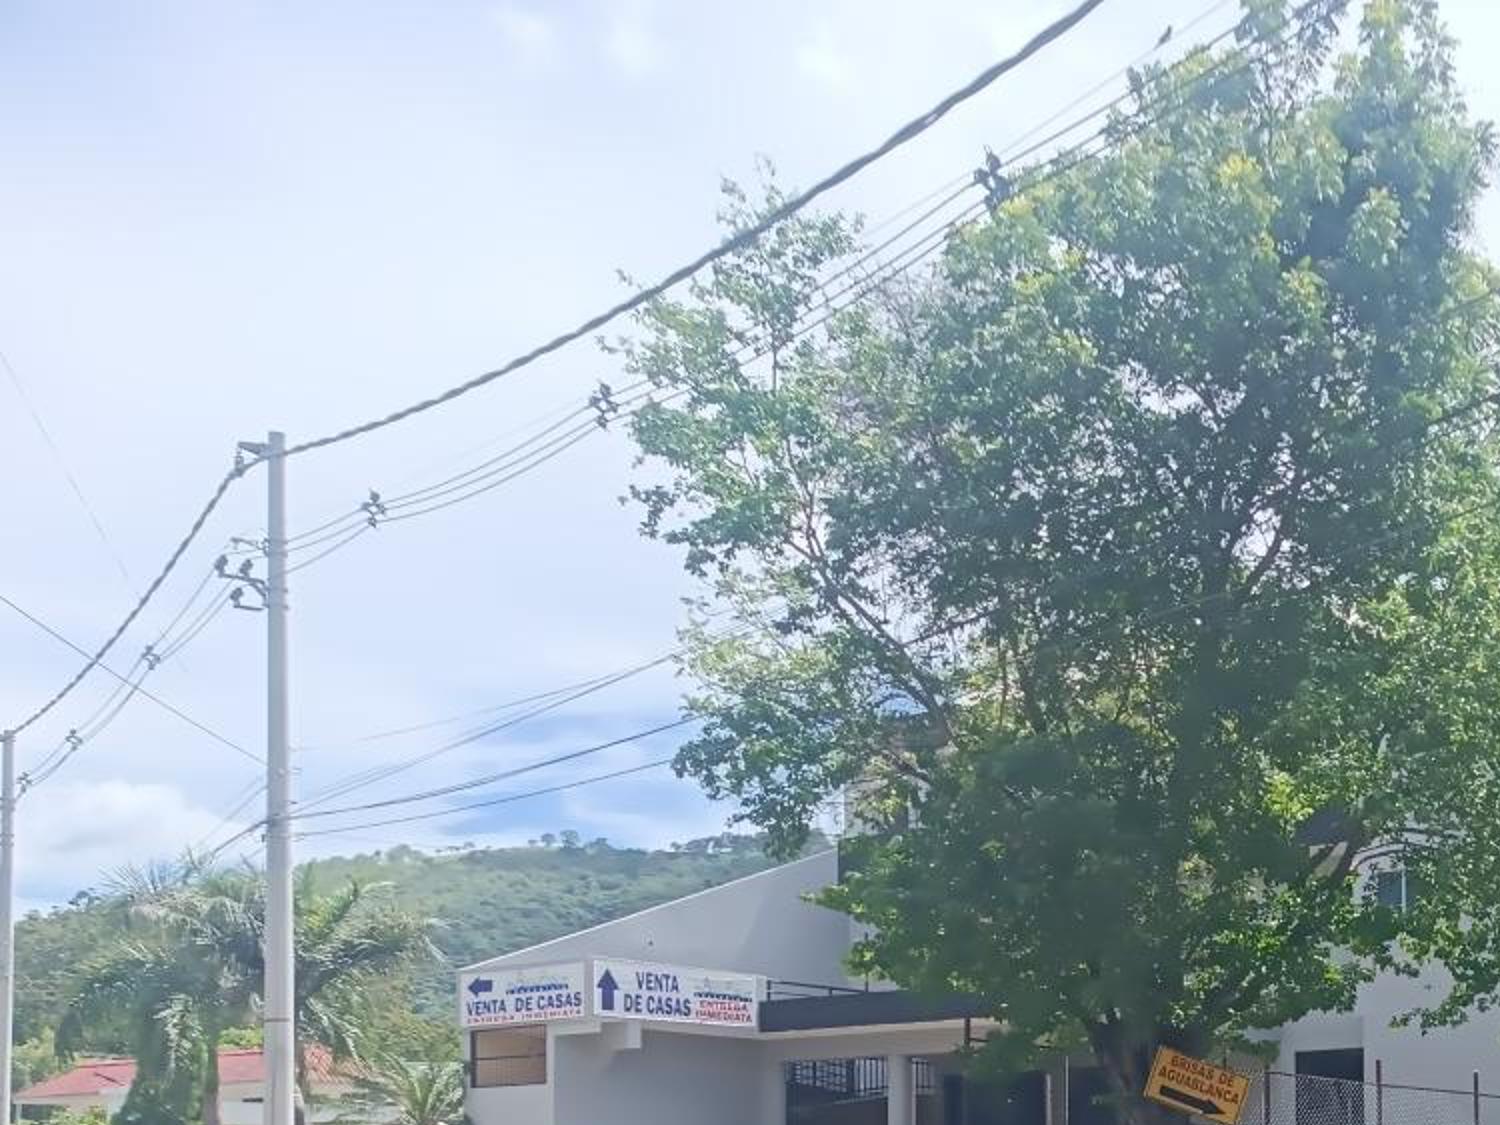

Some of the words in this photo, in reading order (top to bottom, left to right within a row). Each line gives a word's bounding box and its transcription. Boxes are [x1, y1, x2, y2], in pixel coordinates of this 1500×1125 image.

[636, 972, 680, 992] VENTA
[466, 999, 506, 1017] VENTA
[515, 996, 533, 1012] DE
[537, 991, 582, 1010] CASAS
[624, 994, 643, 1013] DE
[646, 995, 692, 1017] CASAS
[1158, 1066, 1239, 1104] AGUABLANCA
[1219, 1073, 1234, 1087] DE
